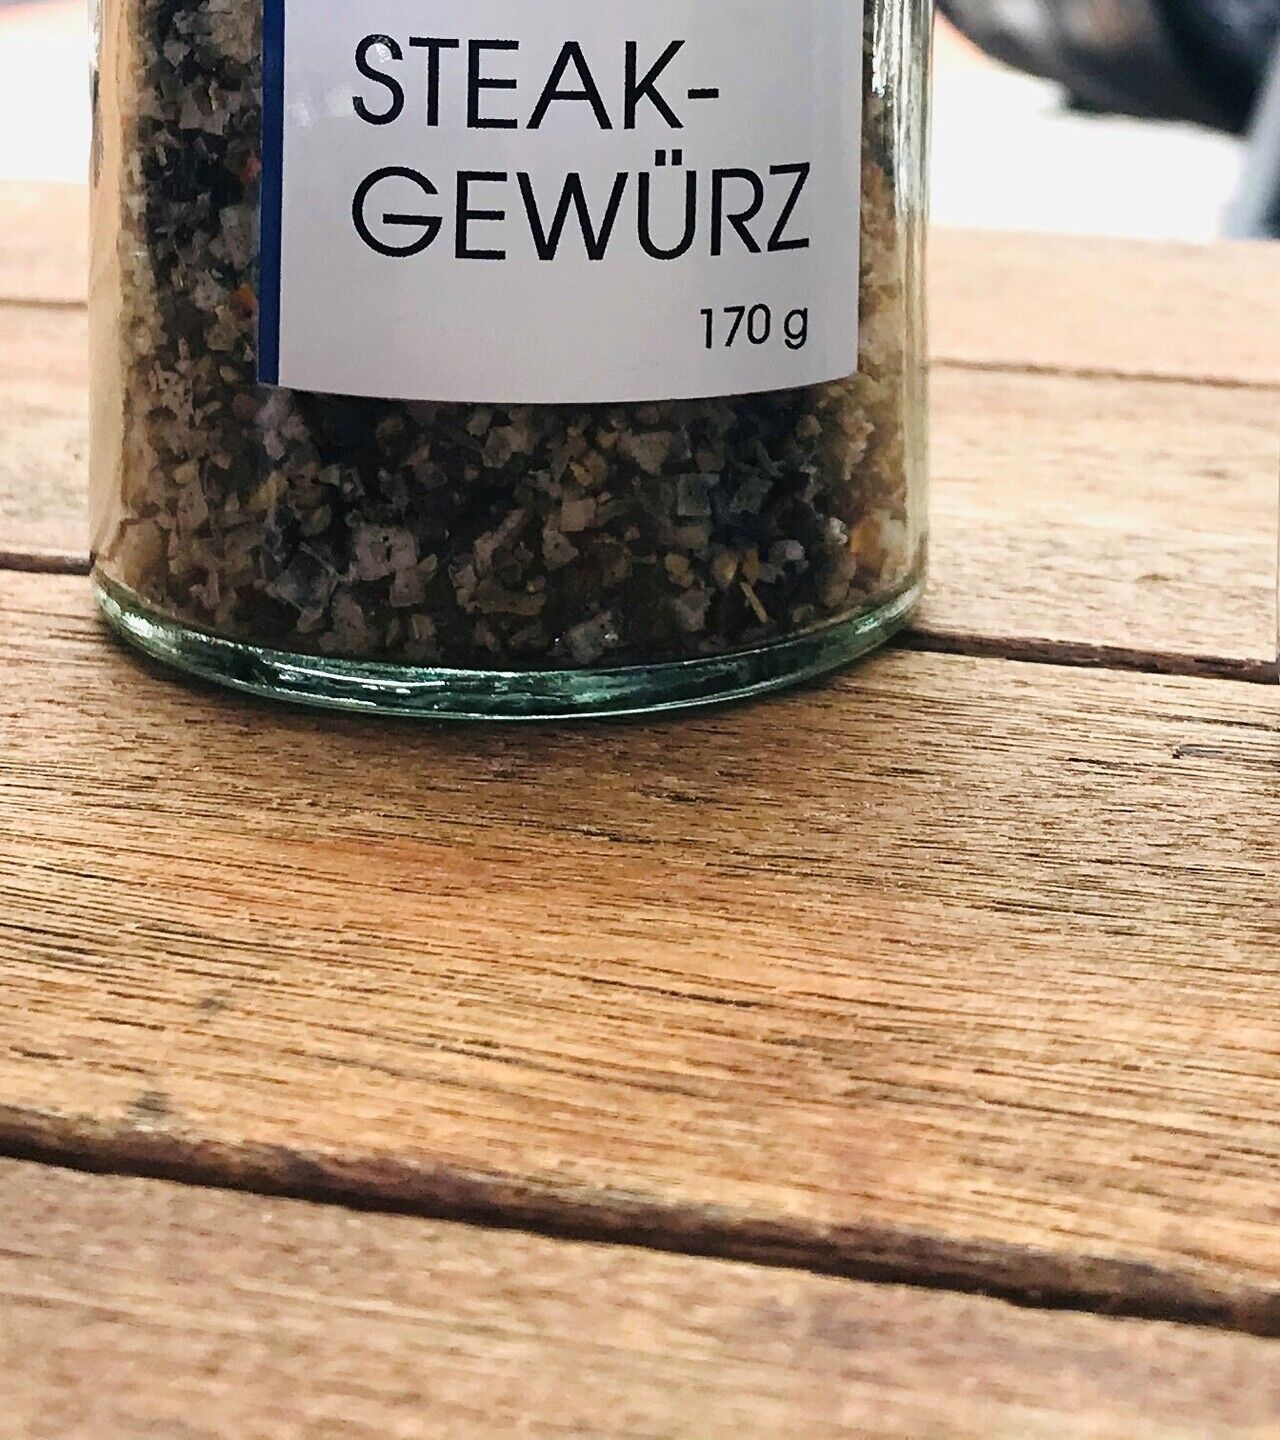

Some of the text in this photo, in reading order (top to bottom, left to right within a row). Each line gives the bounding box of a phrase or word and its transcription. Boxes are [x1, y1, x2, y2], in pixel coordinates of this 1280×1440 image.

[352, 34, 719, 130] STEAK-
[352, 149, 810, 261] GEWÜRZ
[701, 303, 808, 350] 170 g
